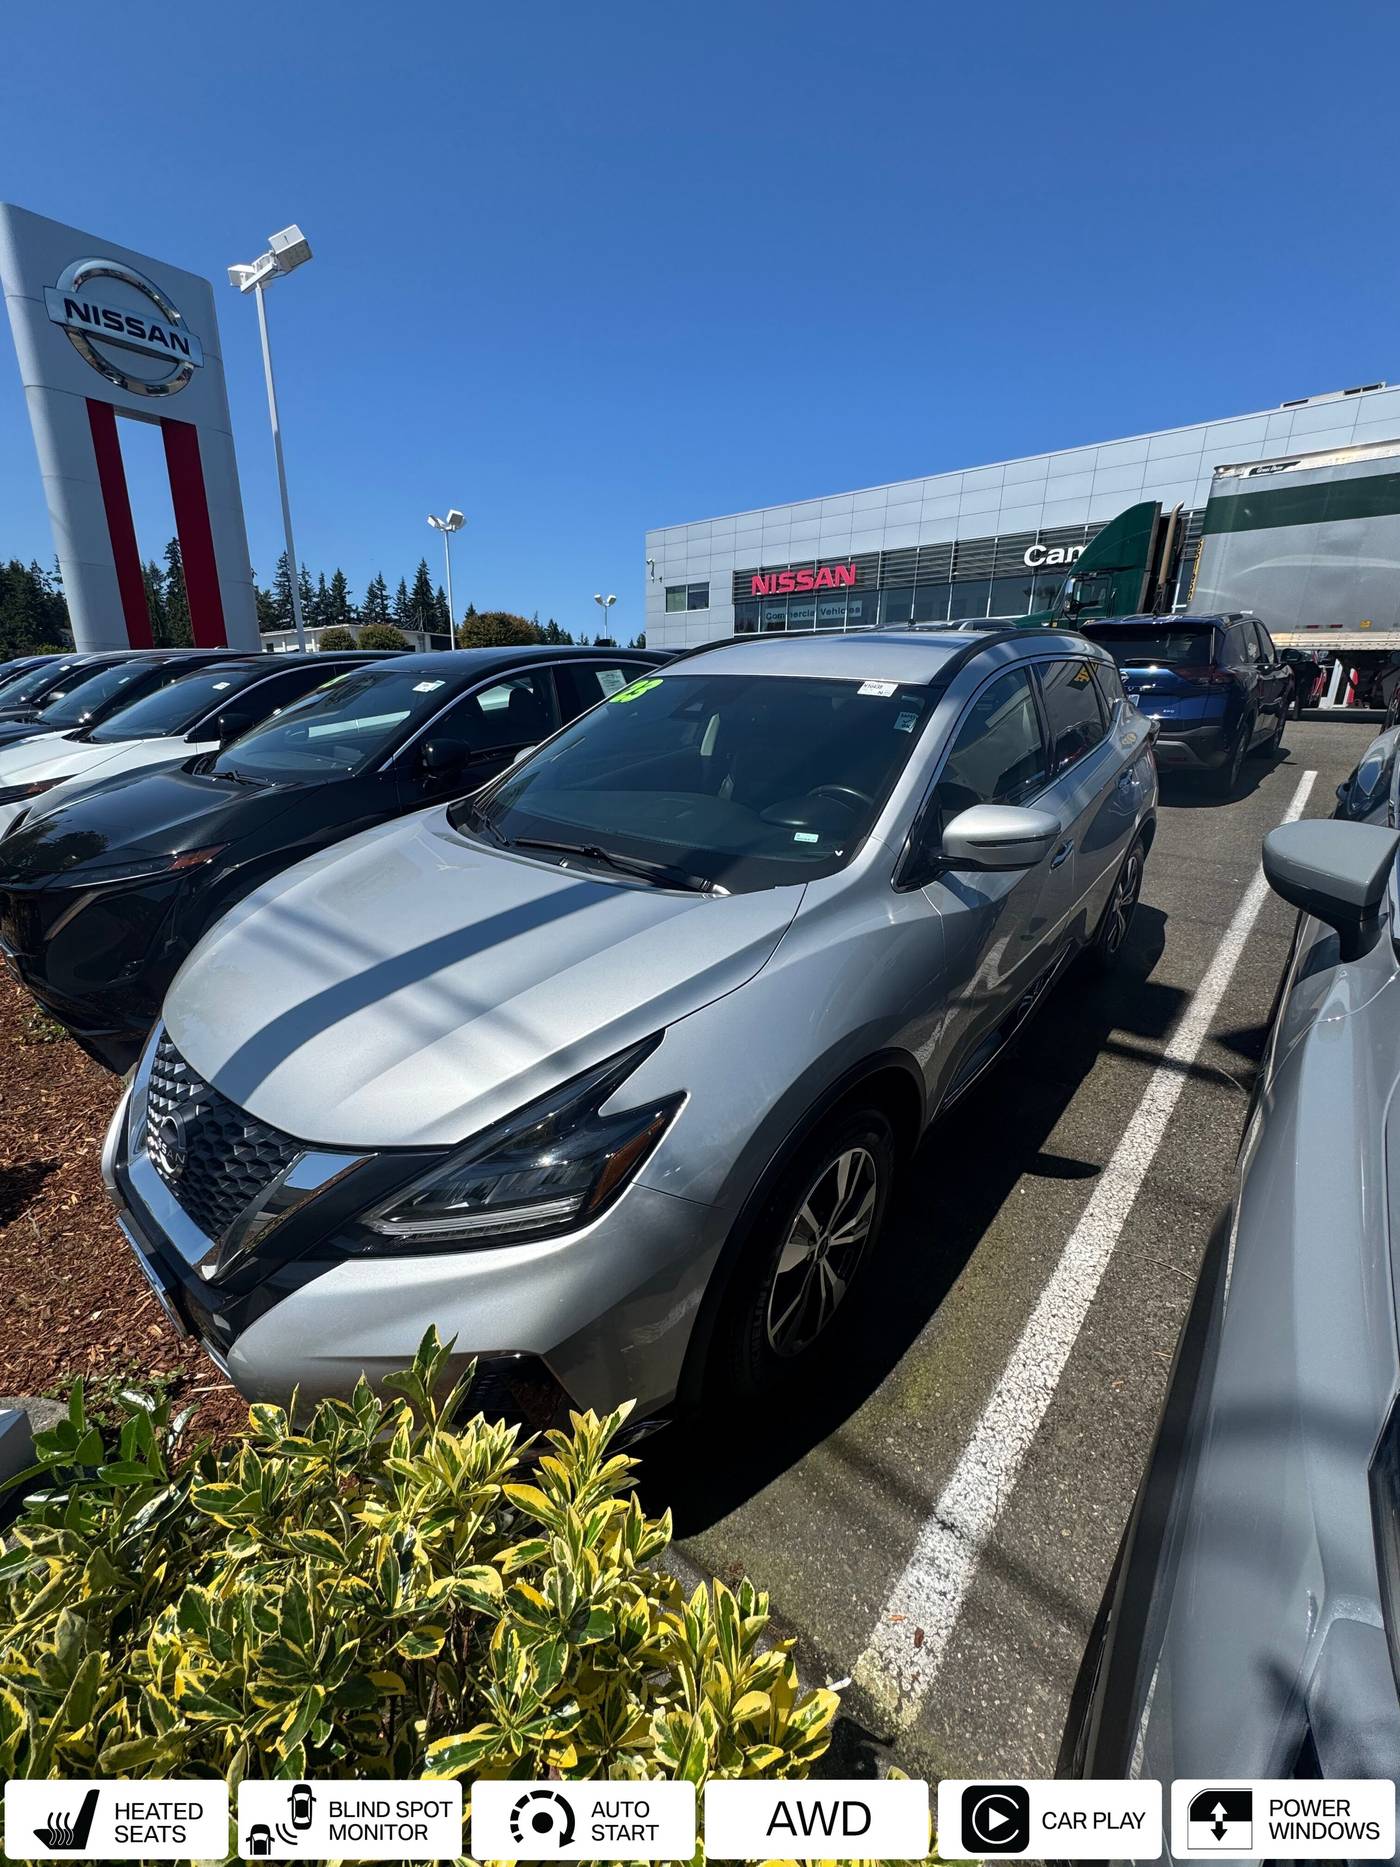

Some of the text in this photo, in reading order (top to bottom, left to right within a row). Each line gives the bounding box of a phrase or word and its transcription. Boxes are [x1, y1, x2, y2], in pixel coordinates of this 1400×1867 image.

[63, 297, 190, 356] NISSAN
[751, 562, 856, 597] NISSAN
[820, 606, 861, 616] Vehices
